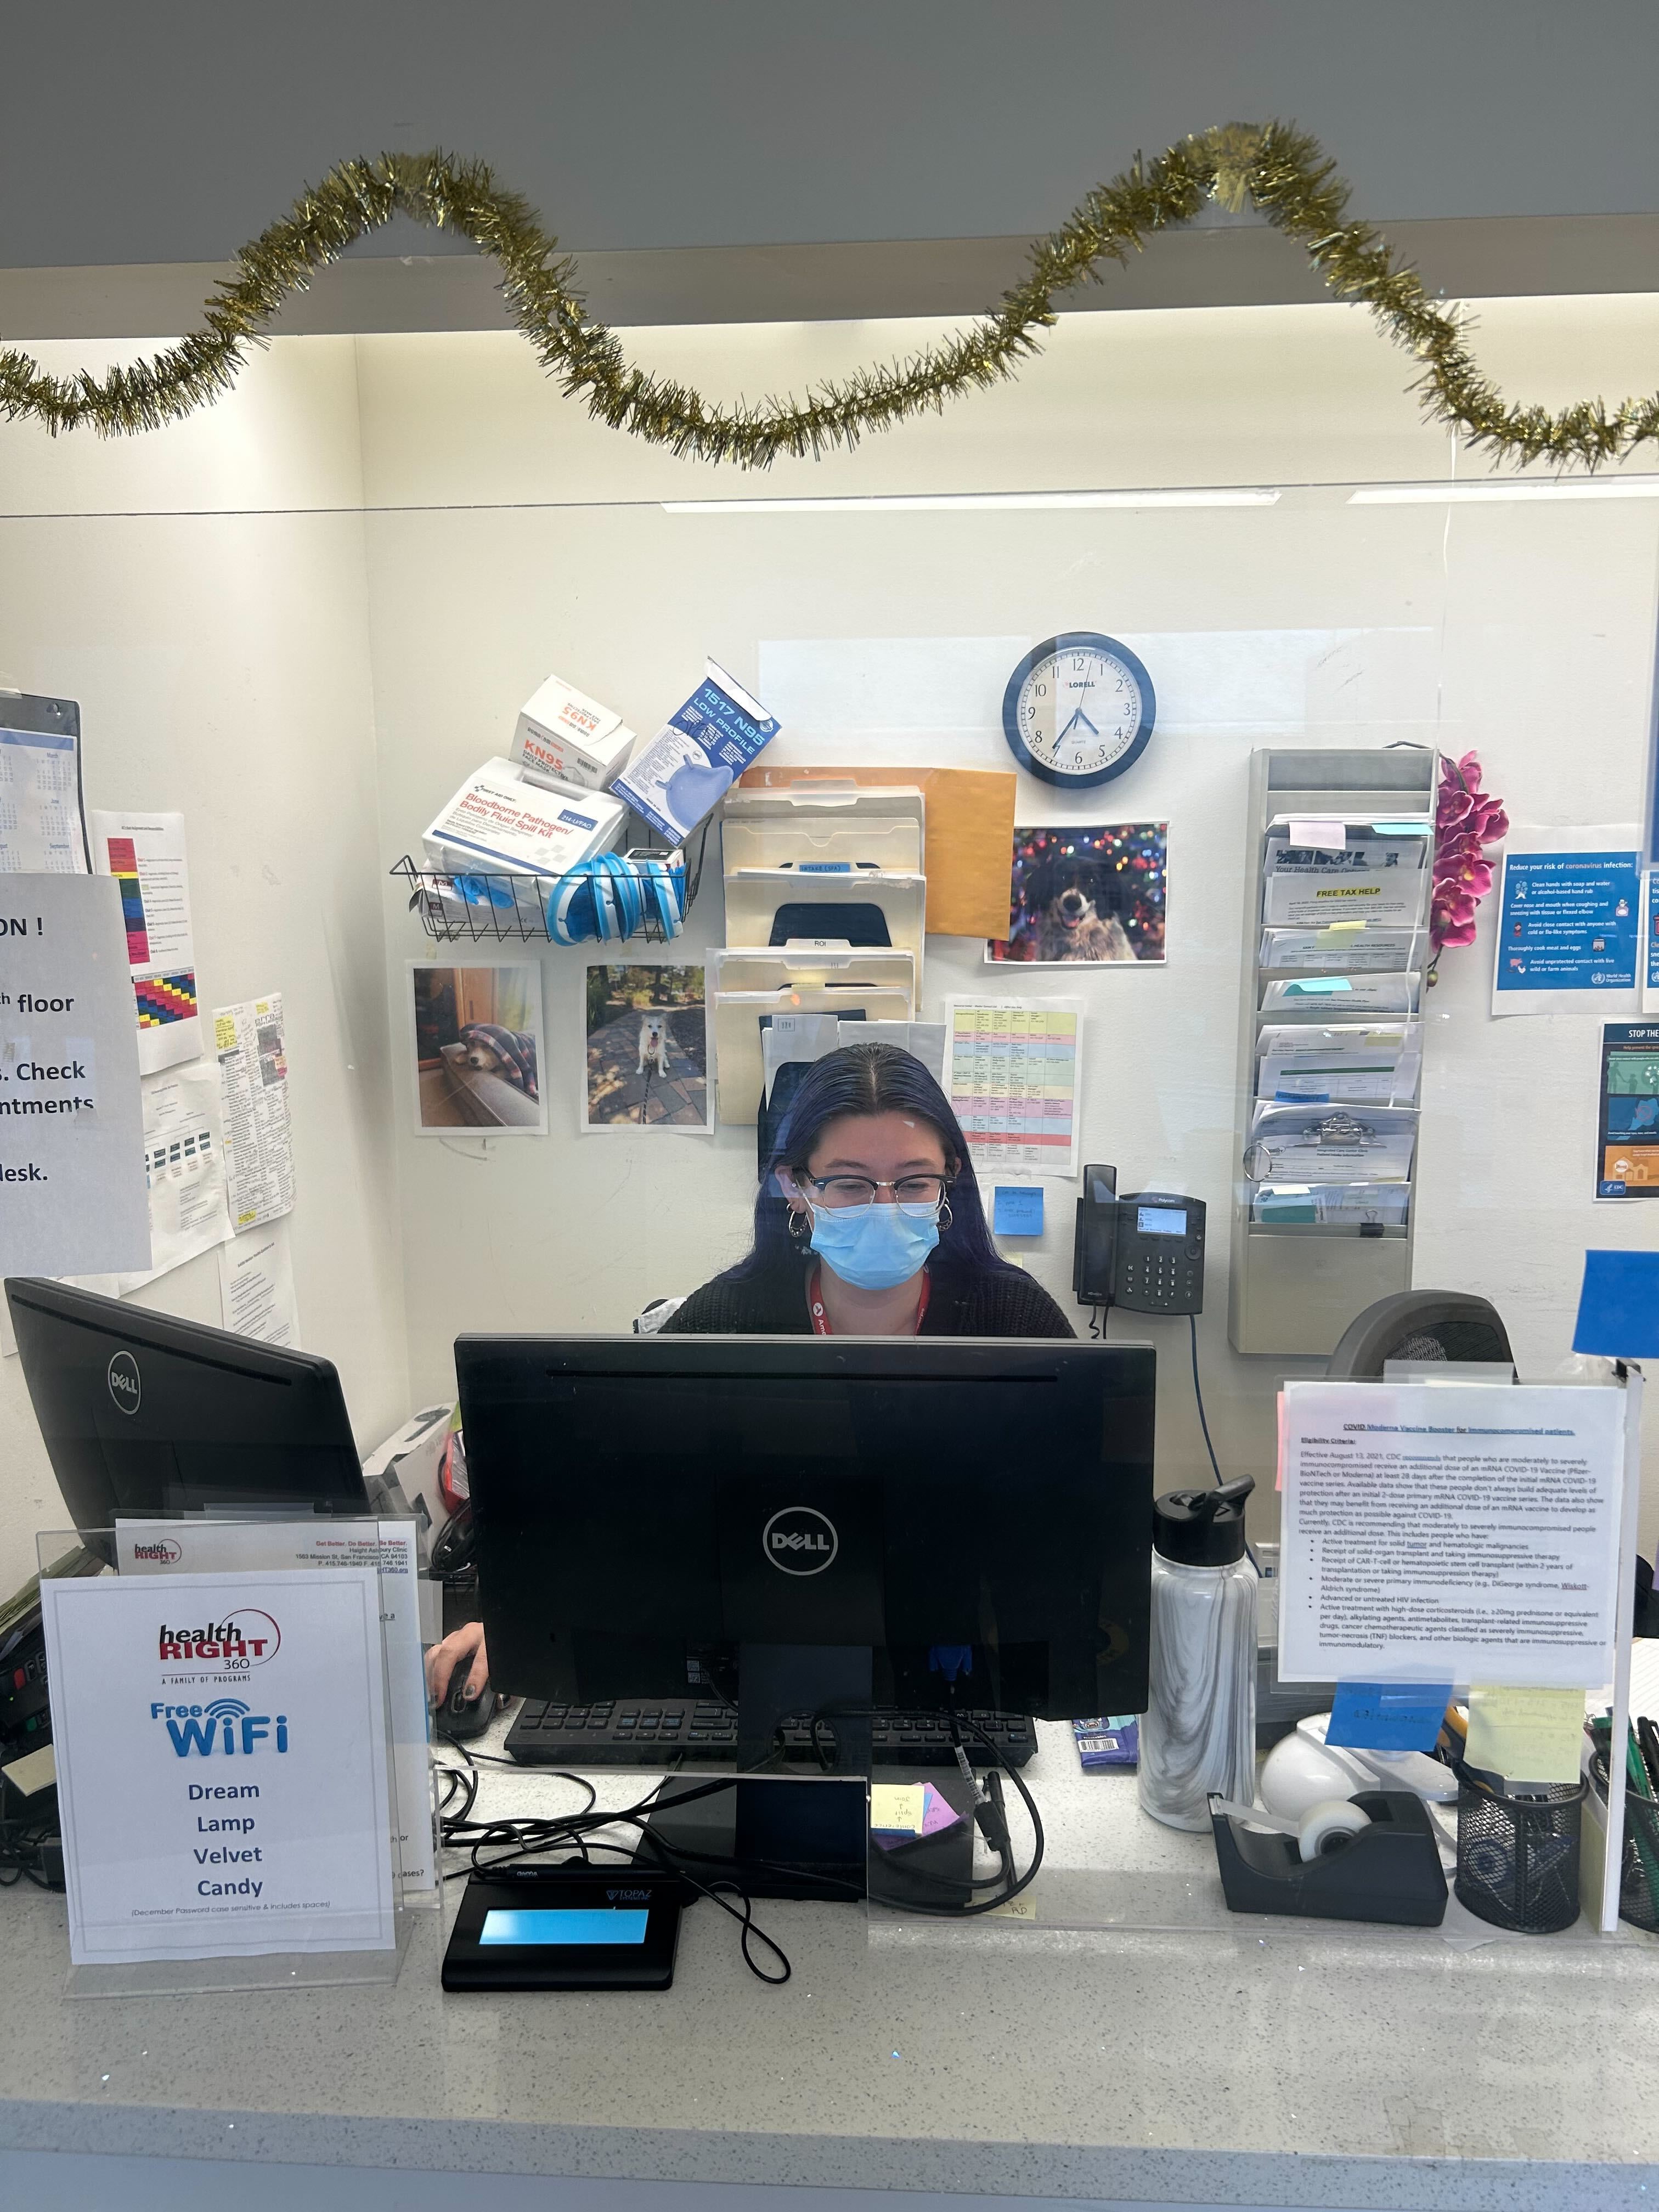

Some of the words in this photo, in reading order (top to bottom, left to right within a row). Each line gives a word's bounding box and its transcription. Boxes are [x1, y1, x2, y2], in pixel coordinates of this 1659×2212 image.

[1052, 666, 1059, 679] 11
[1073, 658, 1085, 671] 12
[1100, 664, 1103, 676] 1
[1035, 684, 1046, 697] 10
[1116, 679, 1123, 692] 2
[704, 687, 735, 715] 1517
[734, 716, 765, 746] N95
[1028, 707, 1036, 720] 9
[1124, 703, 1130, 715] 3
[562, 706, 597, 731] KN95
[693, 697, 716, 718] LOW
[715, 718, 755, 755] PROFILE
[1035, 731, 1042, 743] 8
[1115, 726, 1123, 740] 4
[524, 739, 563, 771] KN95
[1075, 752, 1082, 764] 6
[1098, 745, 1105, 757] 5
[522, 754, 534, 764] FACE
[535, 762, 550, 773] MASK
[481, 787, 494, 795] FIRST
[459, 800, 490, 816] Bodily
[490, 811, 515, 825] Fluid
[515, 820, 538, 833] Spill
[538, 828, 553, 838] Kit
[466, 793, 521, 817] Bloodborne
[523, 812, 574, 835] Pathogen/
[18, 994, 74, 1013] floor
[1628, 1030, 1645, 1038] STOP
[16, 1061, 86, 1081] Check
[0, 1163, 48, 1181] esk.
[111, 1372, 137, 1393] DELL
[134, 1544, 167, 1554] health
[772, 1532, 830, 1550] DELL
[1486, 1542, 1528, 1550] malignancies
[134, 1551, 177, 1560] RIGHT
[1396, 1549, 1429, 1558] transplant
[1468, 1551, 1533, 1560] immunosuppressive
[159, 1622, 241, 1644] health
[159, 1639, 268, 1660] RIGHT
[224, 1658, 250, 1669] 360
[214, 1674, 251, 1683] PROGRAMS
[151, 1702, 202, 1719] Free
[166, 1716, 288, 1757] WiFi
[189, 1784, 259, 1800] Dream
[198, 1815, 255, 1834] Lamp
[194, 1847, 262, 1864] Velvet
[198, 1878, 263, 1898] Candy
[132, 1908, 174, 1917] (December
[176, 1906, 210, 1915] Password
[231, 1904, 261, 1912] sensitive
[302, 1900, 331, 1910] spaces)
